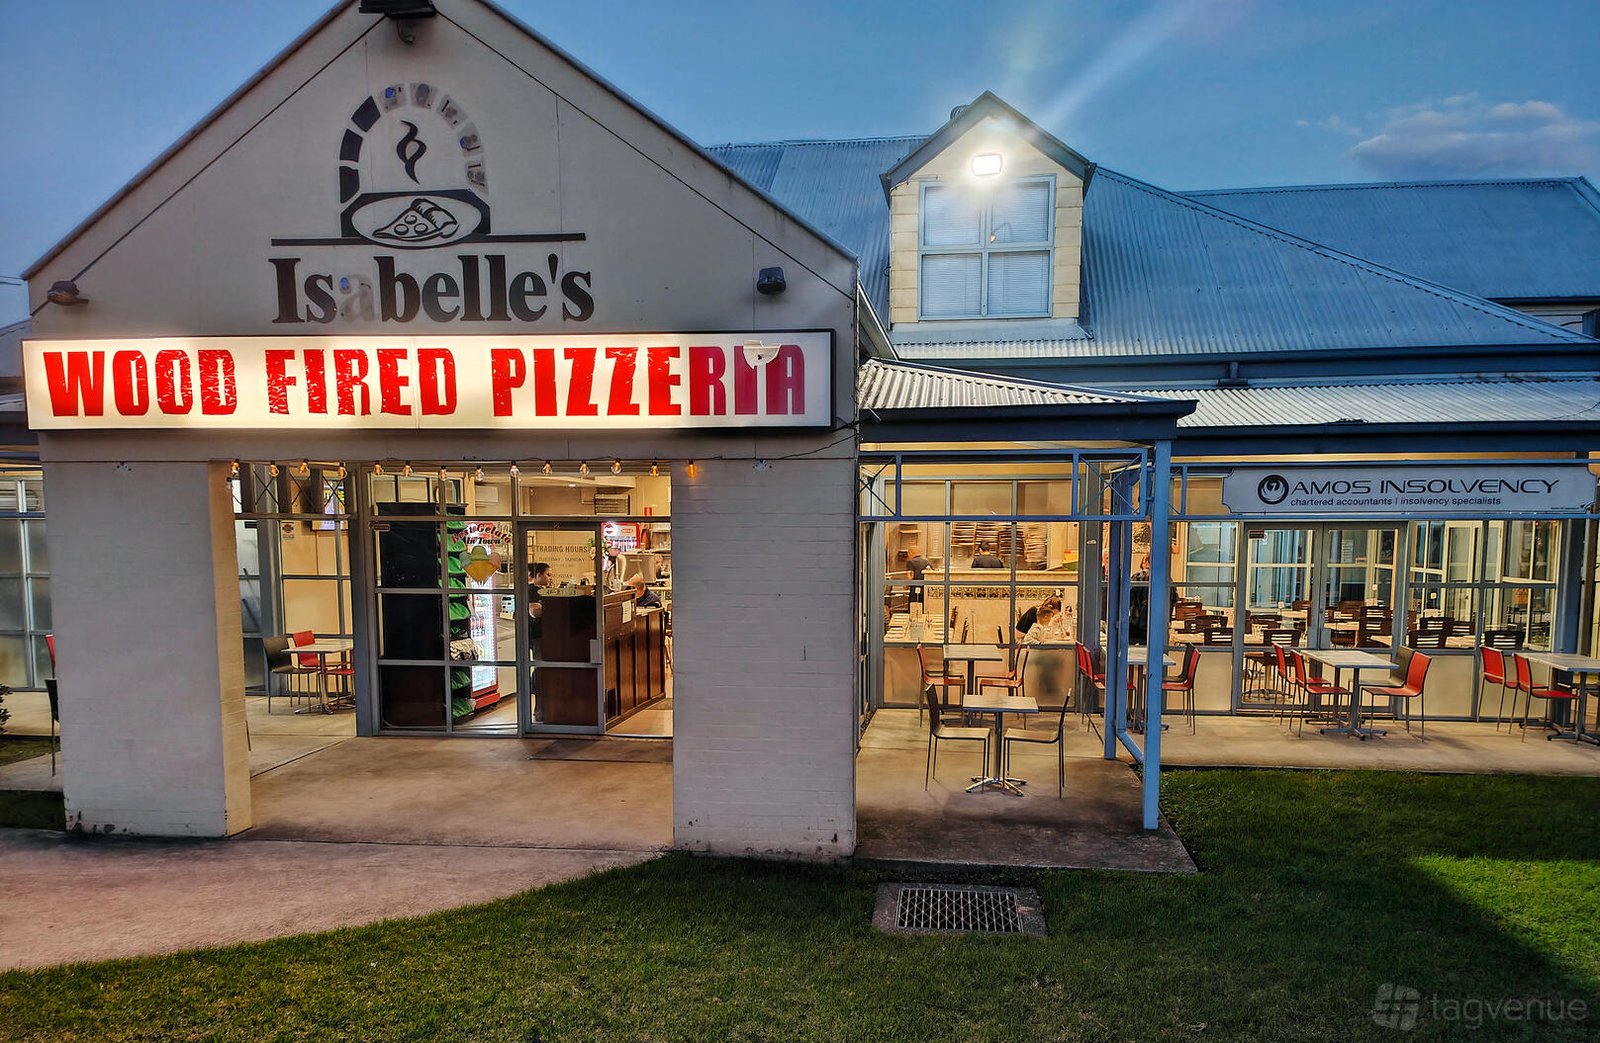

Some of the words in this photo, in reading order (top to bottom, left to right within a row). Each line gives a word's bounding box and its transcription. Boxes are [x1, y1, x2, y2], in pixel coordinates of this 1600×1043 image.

[268, 253, 594, 324] Isabelle's
[43, 349, 238, 417] WOOD
[264, 348, 457, 416] FIRED
[490, 344, 805, 416] PIZZERIA
[1291, 480, 1372, 495] AMOS
[1380, 479, 1559, 494] INSOLVENCY
[1290, 498, 1334, 506] chartered
[1336, 497, 1393, 506] accountants
[1400, 497, 1449, 505] insolvency
[1451, 497, 1502, 506] specialists
[477, 523, 511, 544] Gelato
[479, 536, 501, 545] Town
[536, 545, 564, 553] TRADING
[565, 545, 588, 553] HOURS
